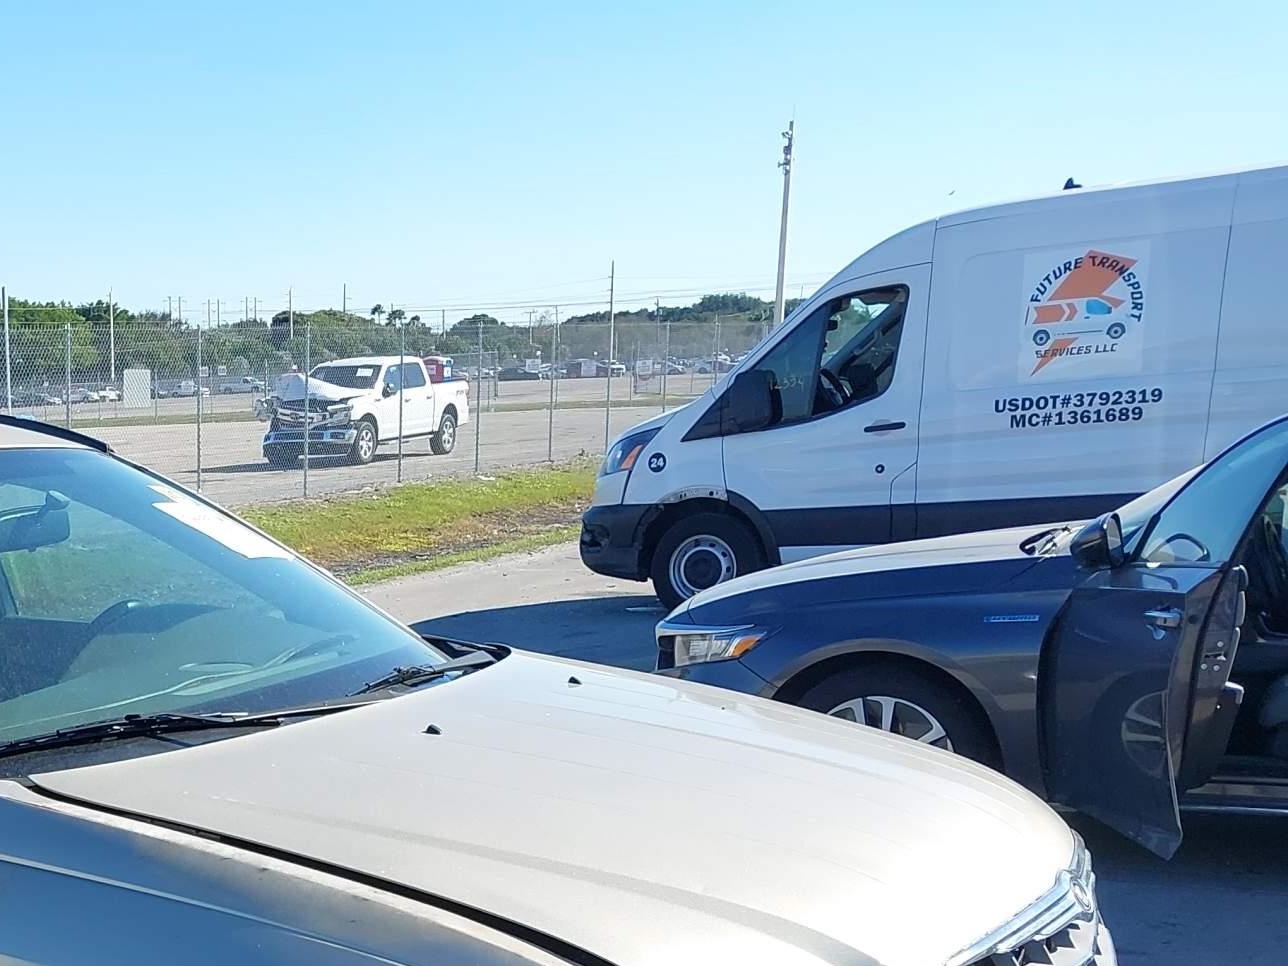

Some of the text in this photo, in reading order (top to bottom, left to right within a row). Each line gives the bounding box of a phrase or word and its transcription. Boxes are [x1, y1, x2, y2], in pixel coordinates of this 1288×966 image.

[1030, 255, 1144, 322] FUTURE TRANSPORT
[1035, 343, 1118, 359] SERVICES LLC
[994, 388, 1163, 413] USDOT#3792319
[1010, 407, 1143, 428] MC#1361689
[650, 457, 664, 468] 24
